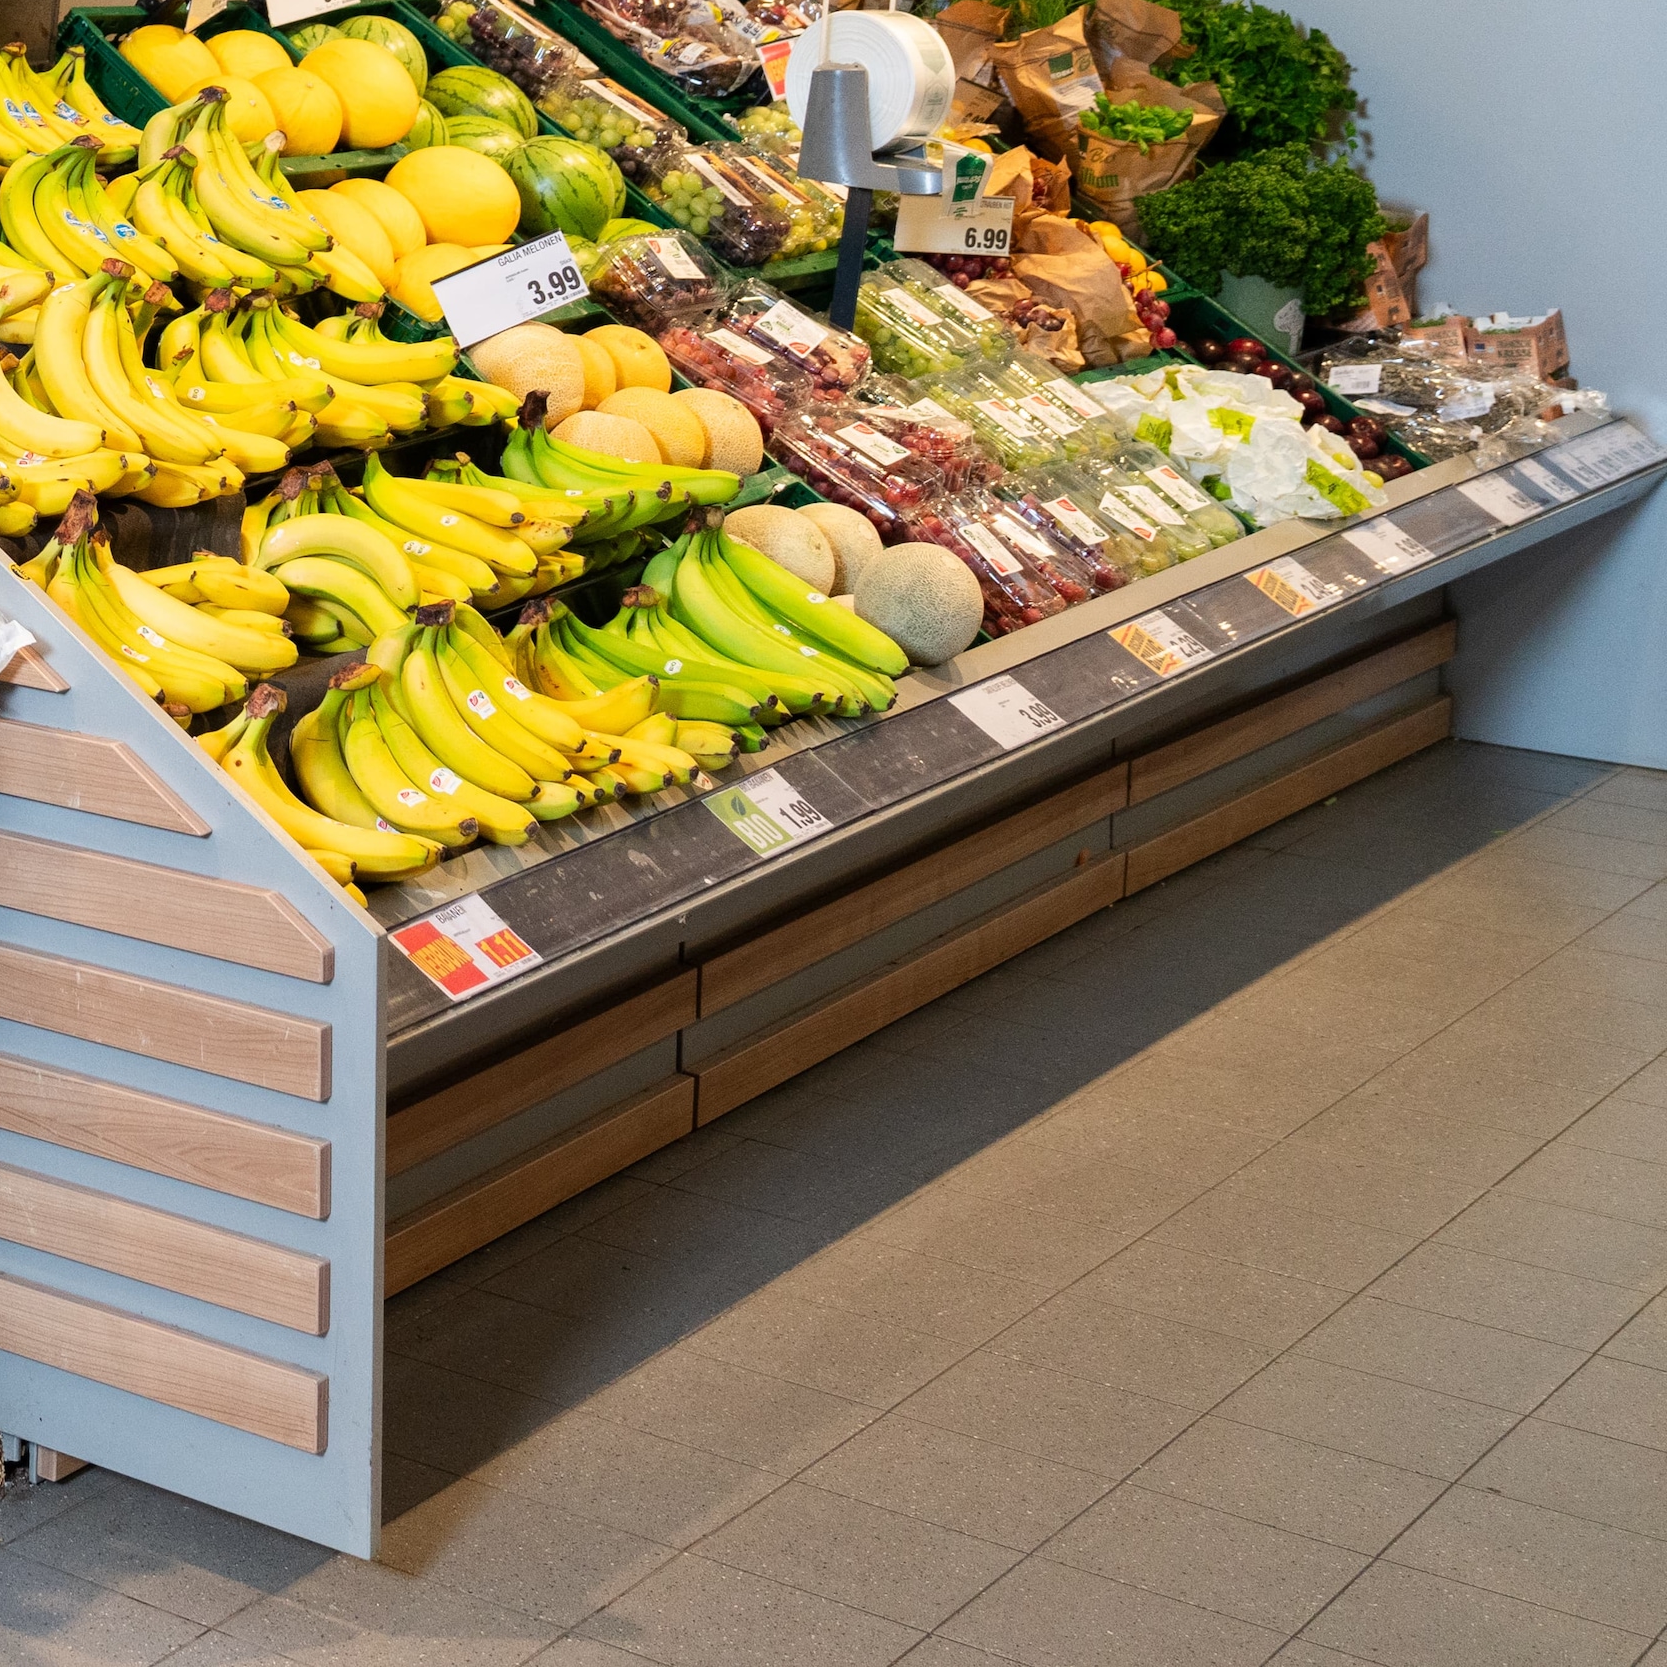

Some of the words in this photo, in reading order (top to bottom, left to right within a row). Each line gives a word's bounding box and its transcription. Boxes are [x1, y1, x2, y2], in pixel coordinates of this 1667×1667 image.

[497, 250, 522, 268] GALIA
[522, 233, 563, 258] MELONEN
[964, 227, 1008, 250] 6.99
[527, 265, 581, 305] 3.99
[1018, 702, 1059, 729] 3.99
[732, 812, 784, 850] BIO
[779, 799, 822, 831] 1.99
[480, 928, 531, 967] 1.11
